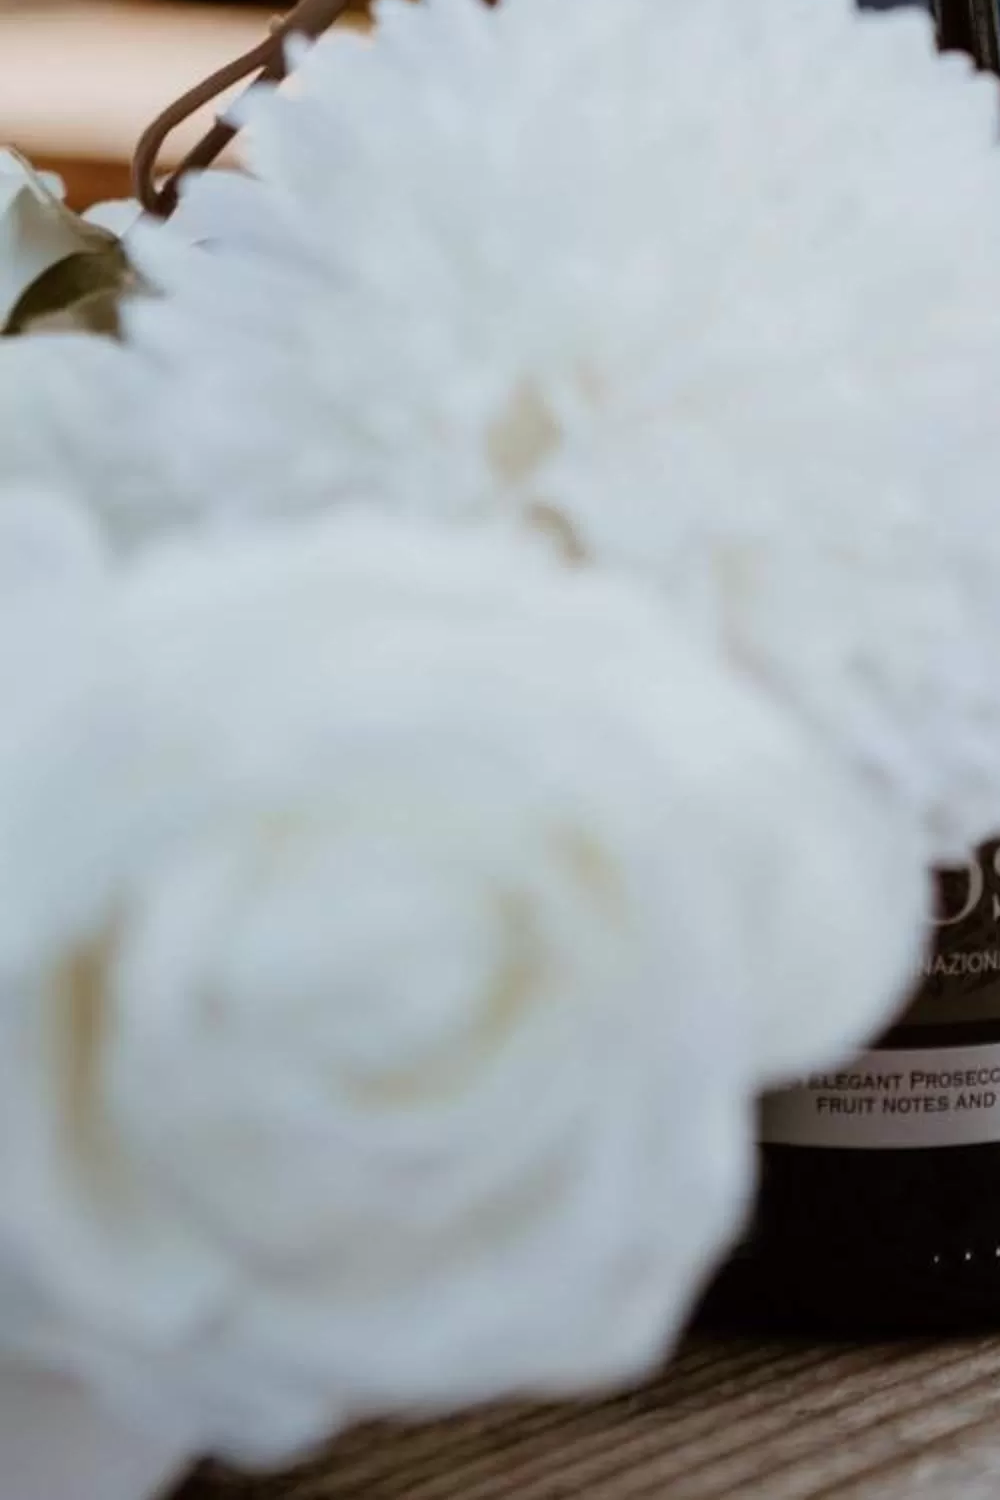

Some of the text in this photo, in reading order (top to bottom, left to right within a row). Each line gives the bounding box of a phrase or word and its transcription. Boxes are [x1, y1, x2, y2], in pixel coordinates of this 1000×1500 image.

[816, 1096, 877, 1116] FRUIT
[882, 1096, 949, 1114] NOTES
[954, 1091, 997, 1112] AND
